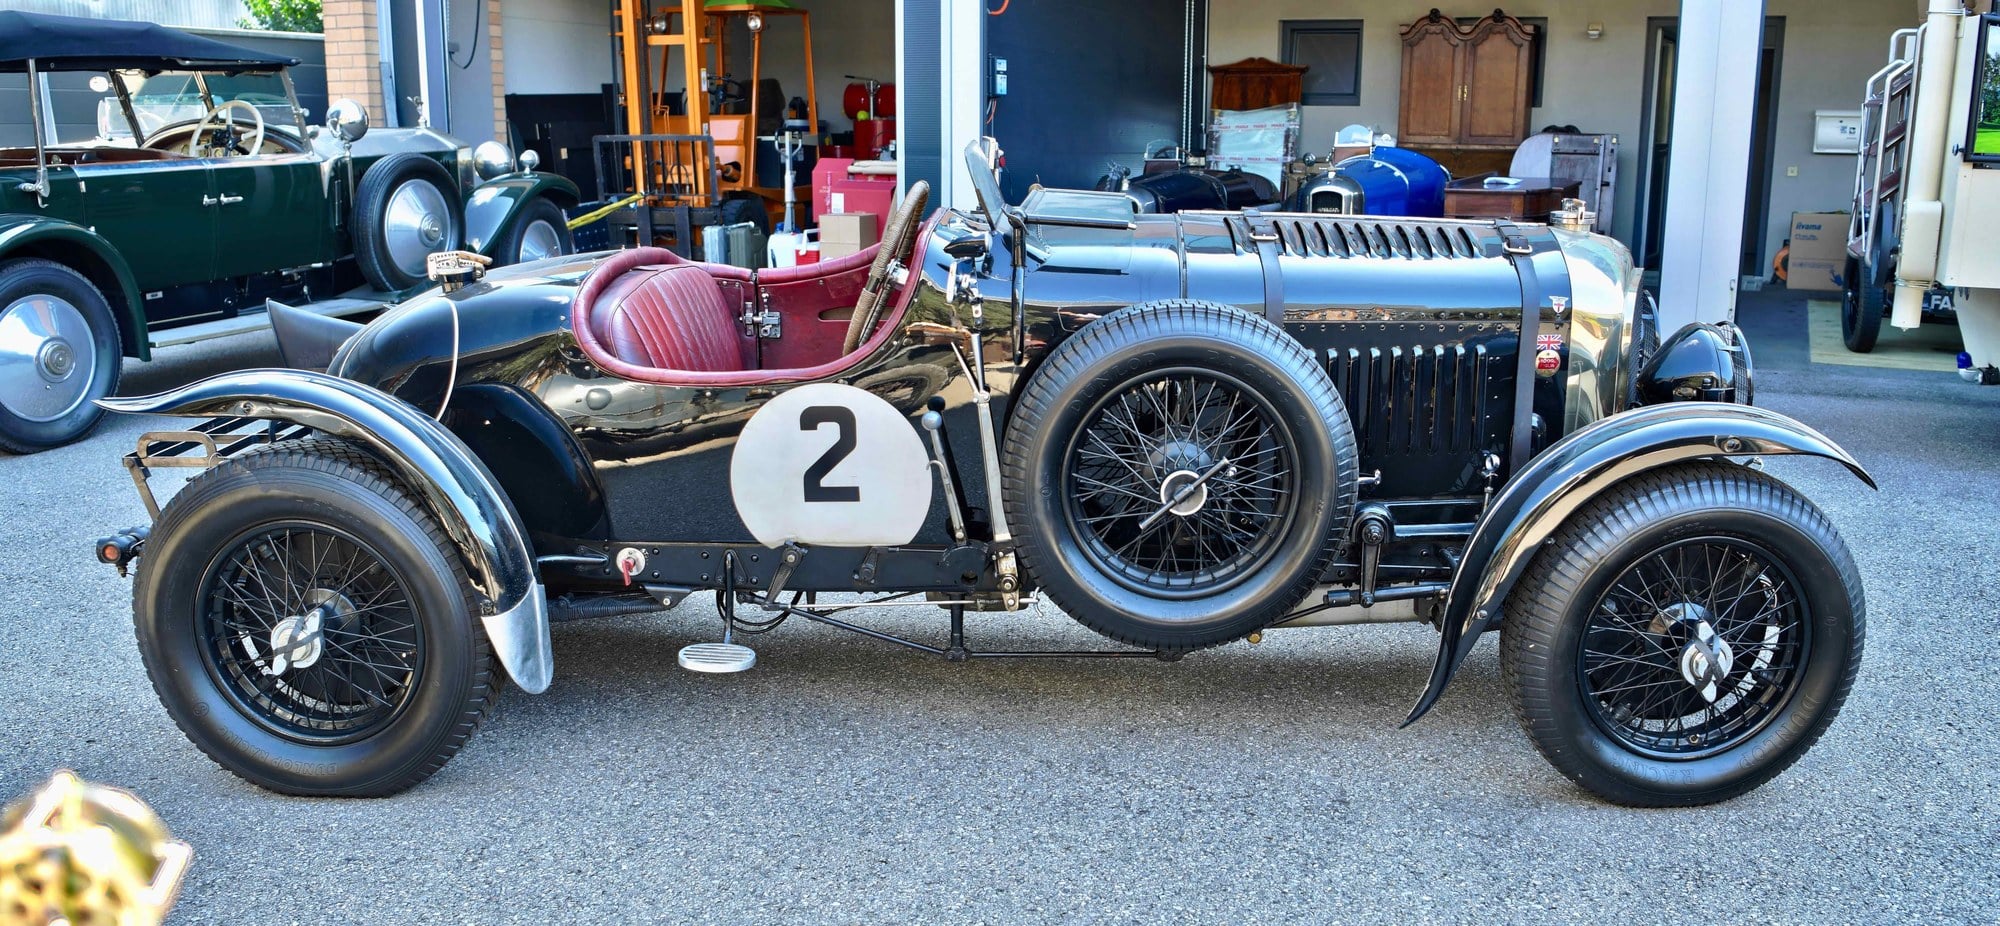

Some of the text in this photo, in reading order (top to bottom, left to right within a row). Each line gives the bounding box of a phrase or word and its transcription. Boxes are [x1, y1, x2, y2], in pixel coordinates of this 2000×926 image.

[1930, 294, 1956, 310] FA
[1070, 351, 1157, 413] DUNLOP
[800, 405, 861, 502] 2
[272, 757, 337, 776] DUNLOP
[1611, 694, 1821, 785] DUNLOP RACING
